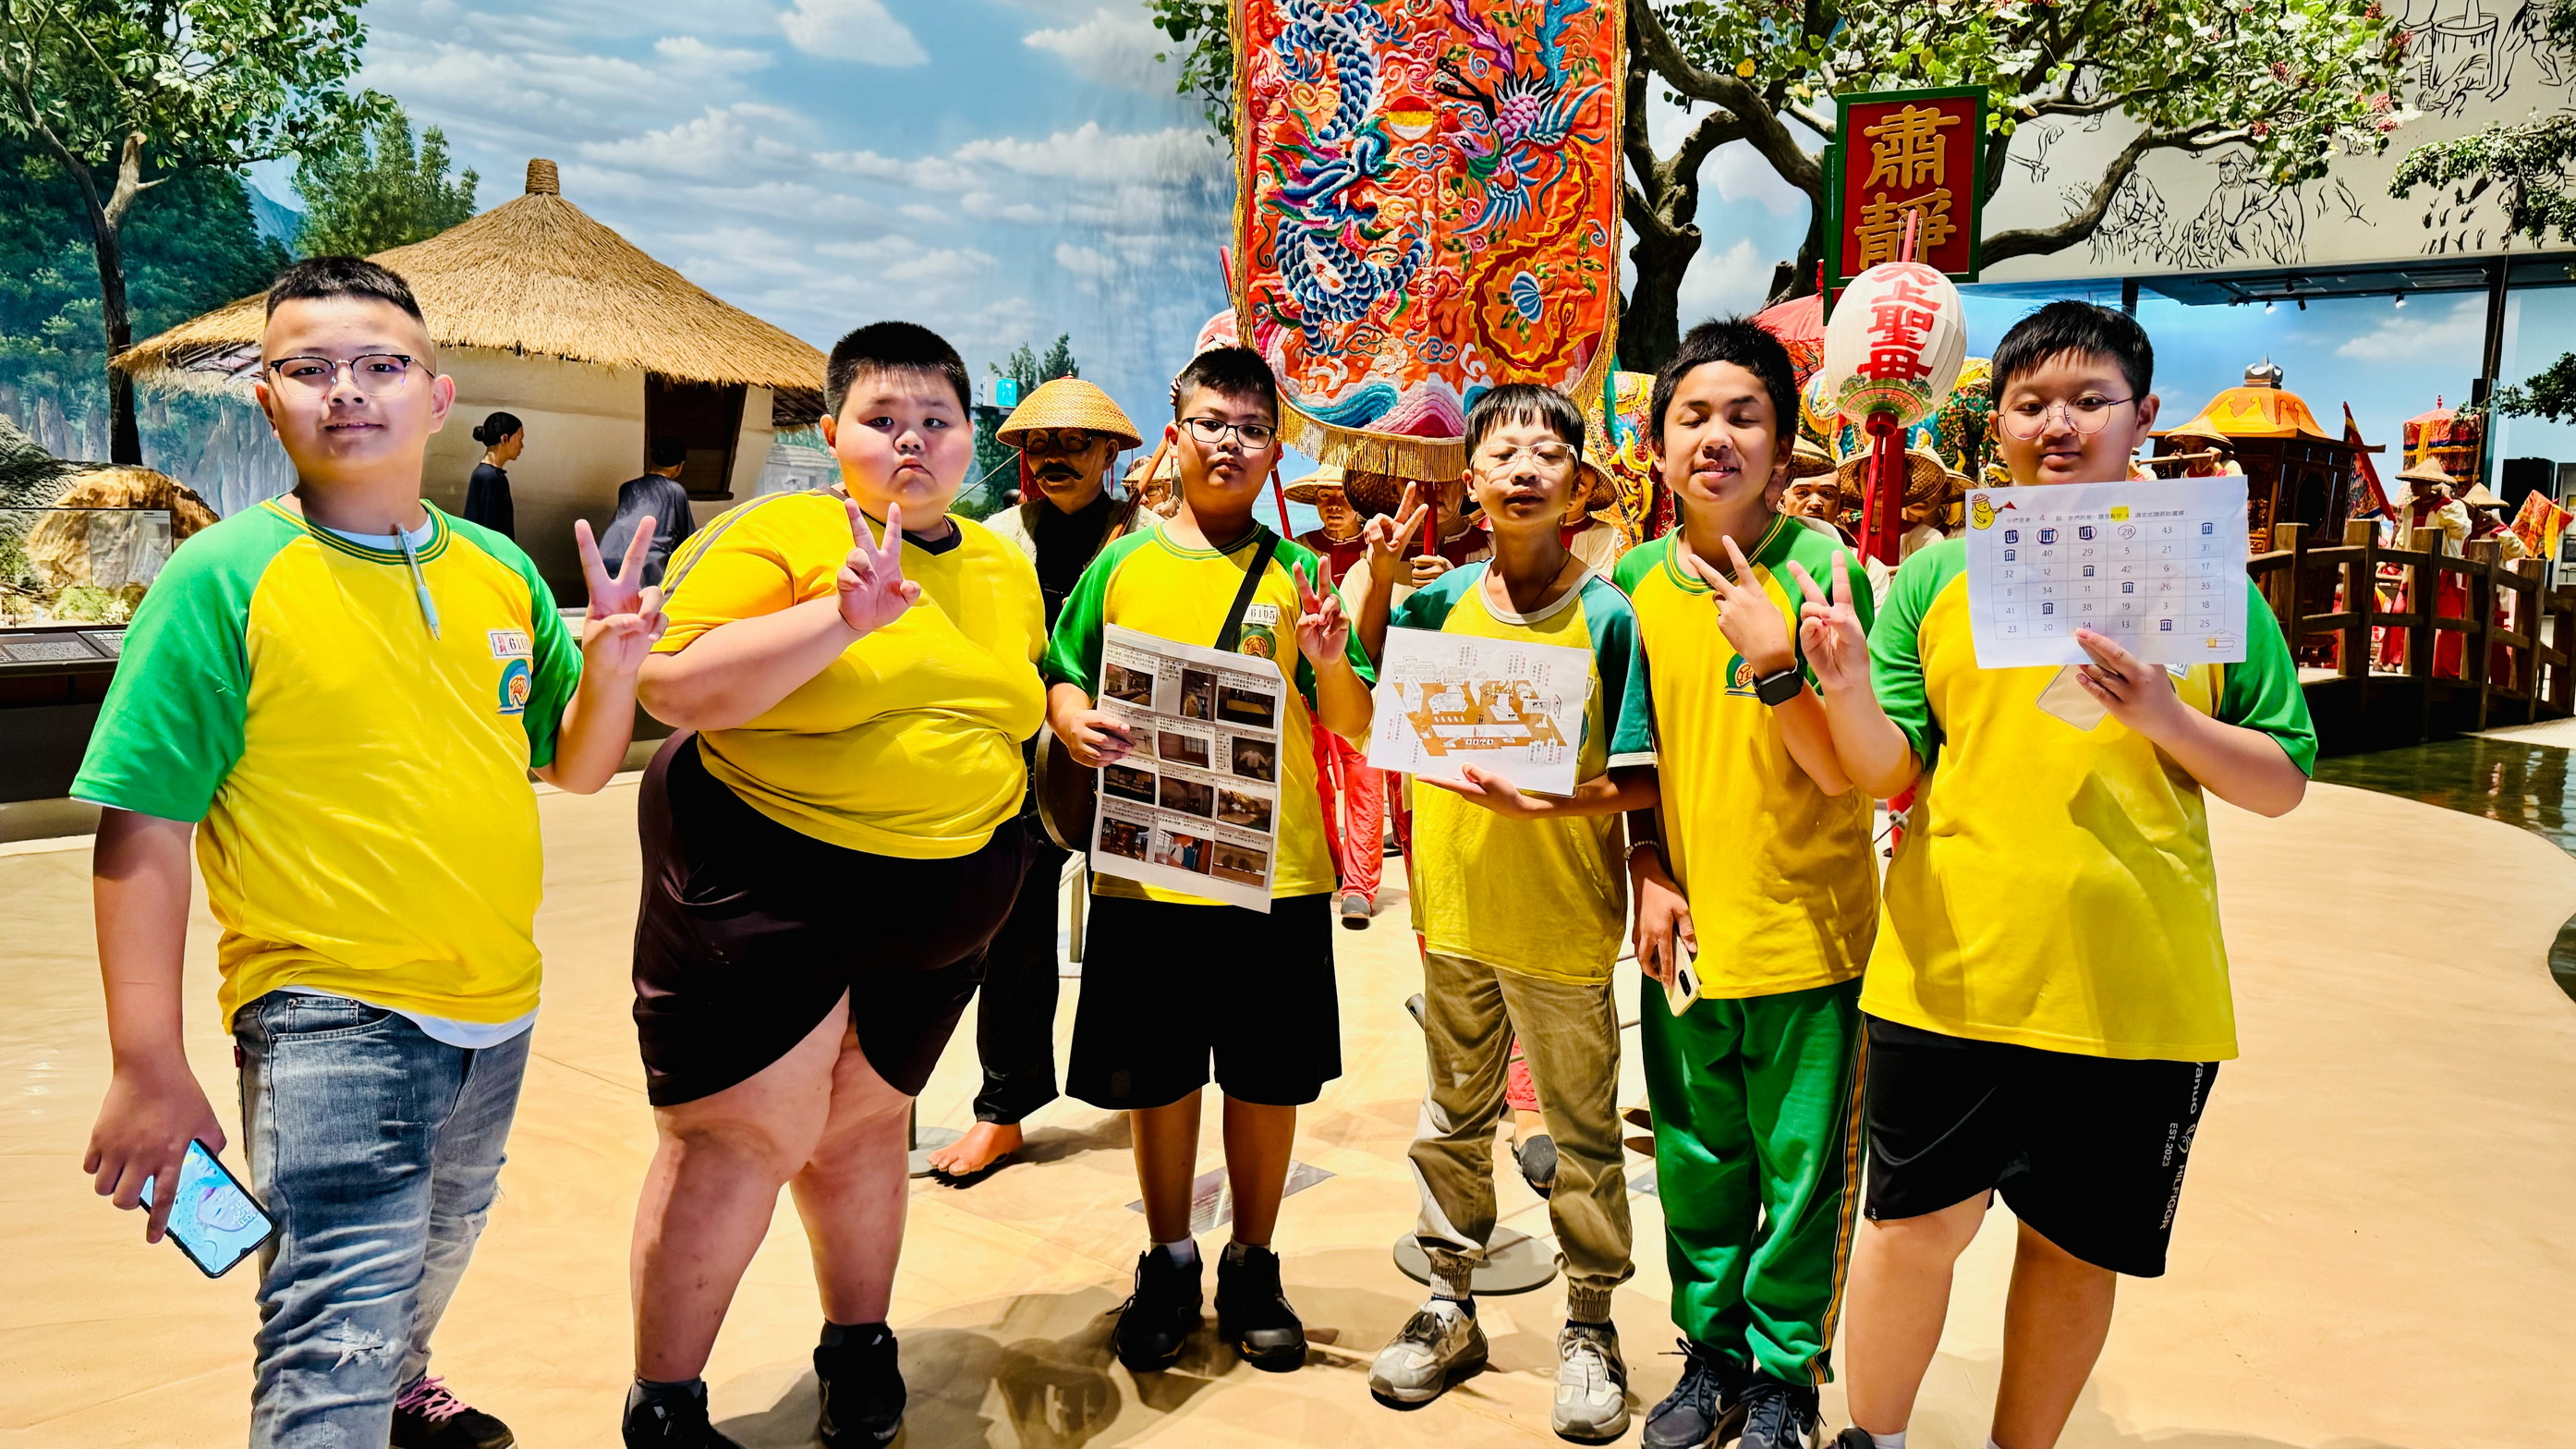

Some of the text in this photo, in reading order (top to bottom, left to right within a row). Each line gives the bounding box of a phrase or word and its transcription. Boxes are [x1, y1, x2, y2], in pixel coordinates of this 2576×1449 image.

[1853, 104, 1960, 271] 肅靜
[2121, 528, 2133, 536] 28
[2082, 548, 2093, 556] 29
[1250, 608, 1275, 620] 6105
